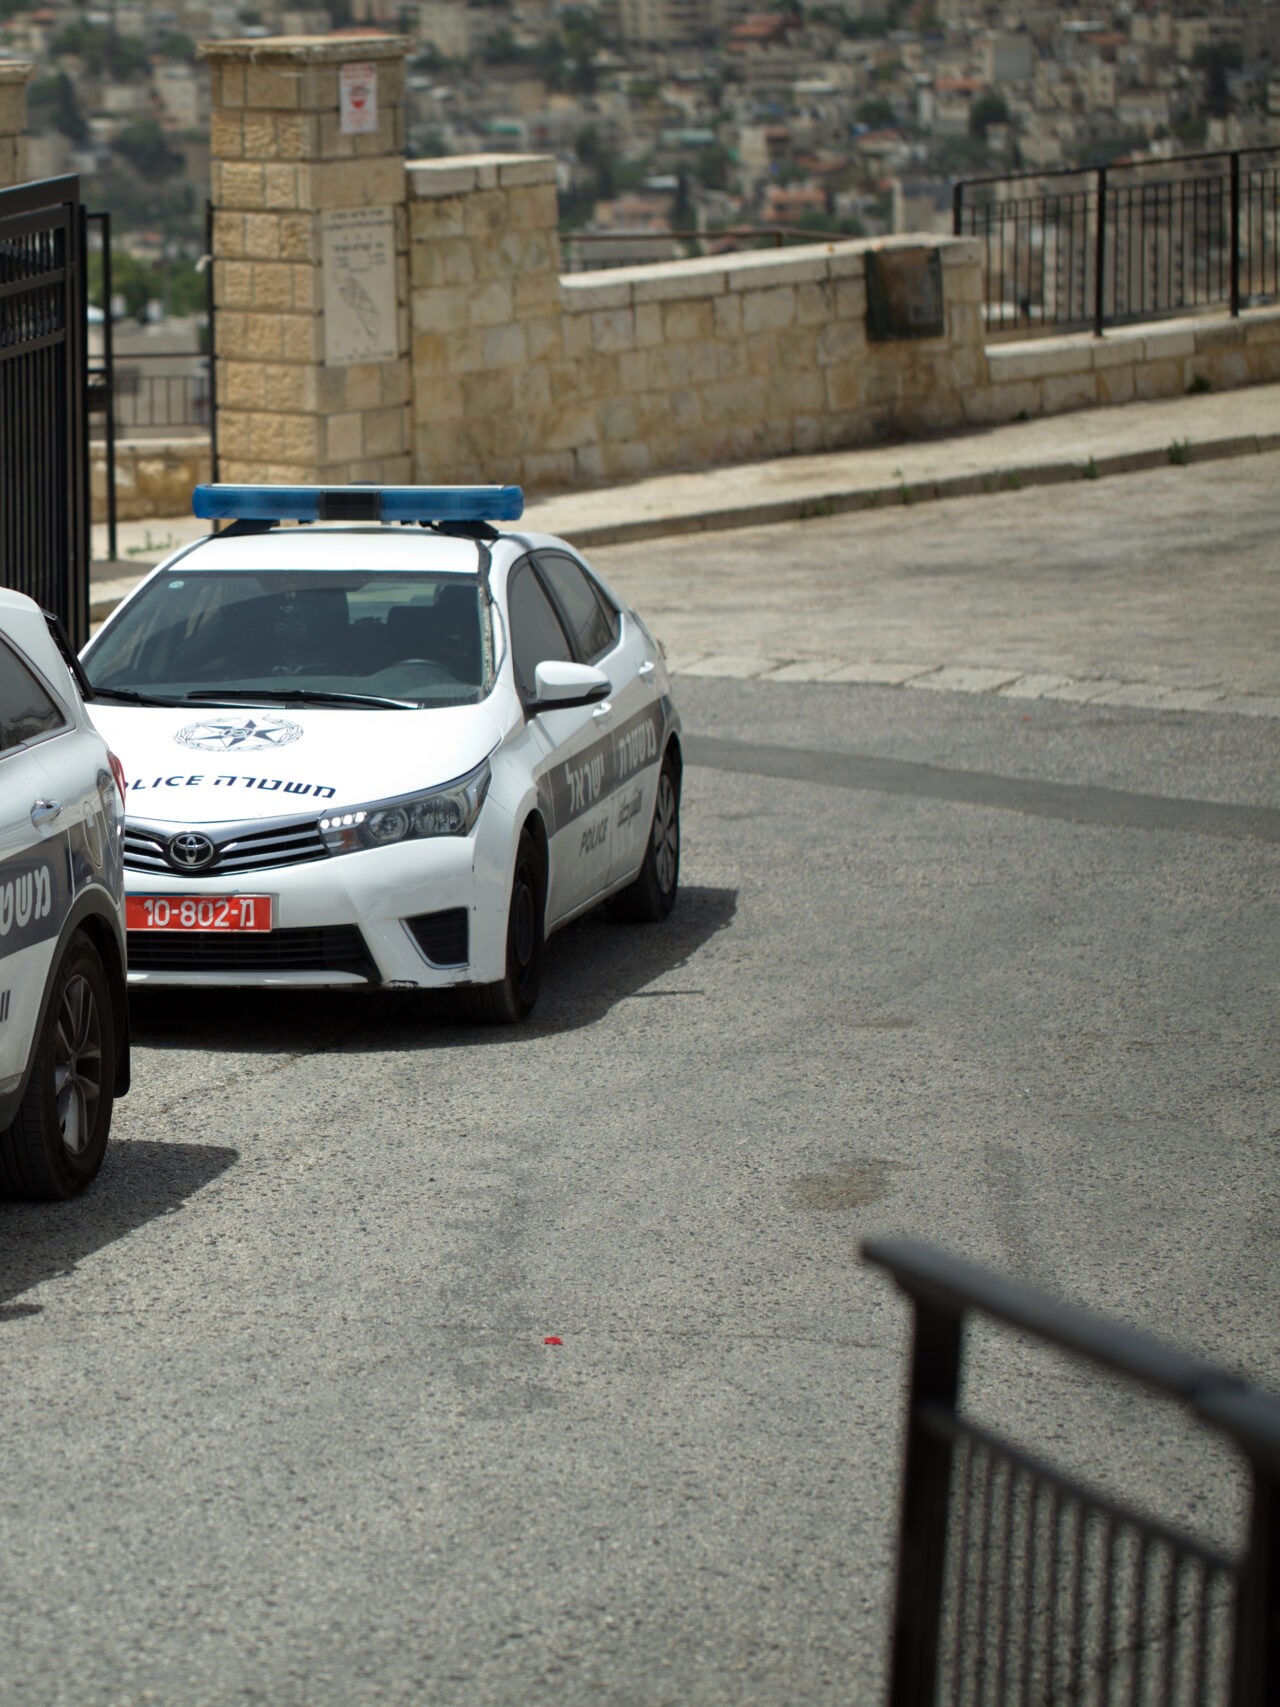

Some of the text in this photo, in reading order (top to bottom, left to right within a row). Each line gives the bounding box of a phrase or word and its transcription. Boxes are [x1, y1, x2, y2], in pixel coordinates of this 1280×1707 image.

[124, 775, 205, 791] LICE
[213, 775, 337, 799] משטרה
[565, 753, 605, 814] ישראל
[580, 817, 608, 857] POLICE
